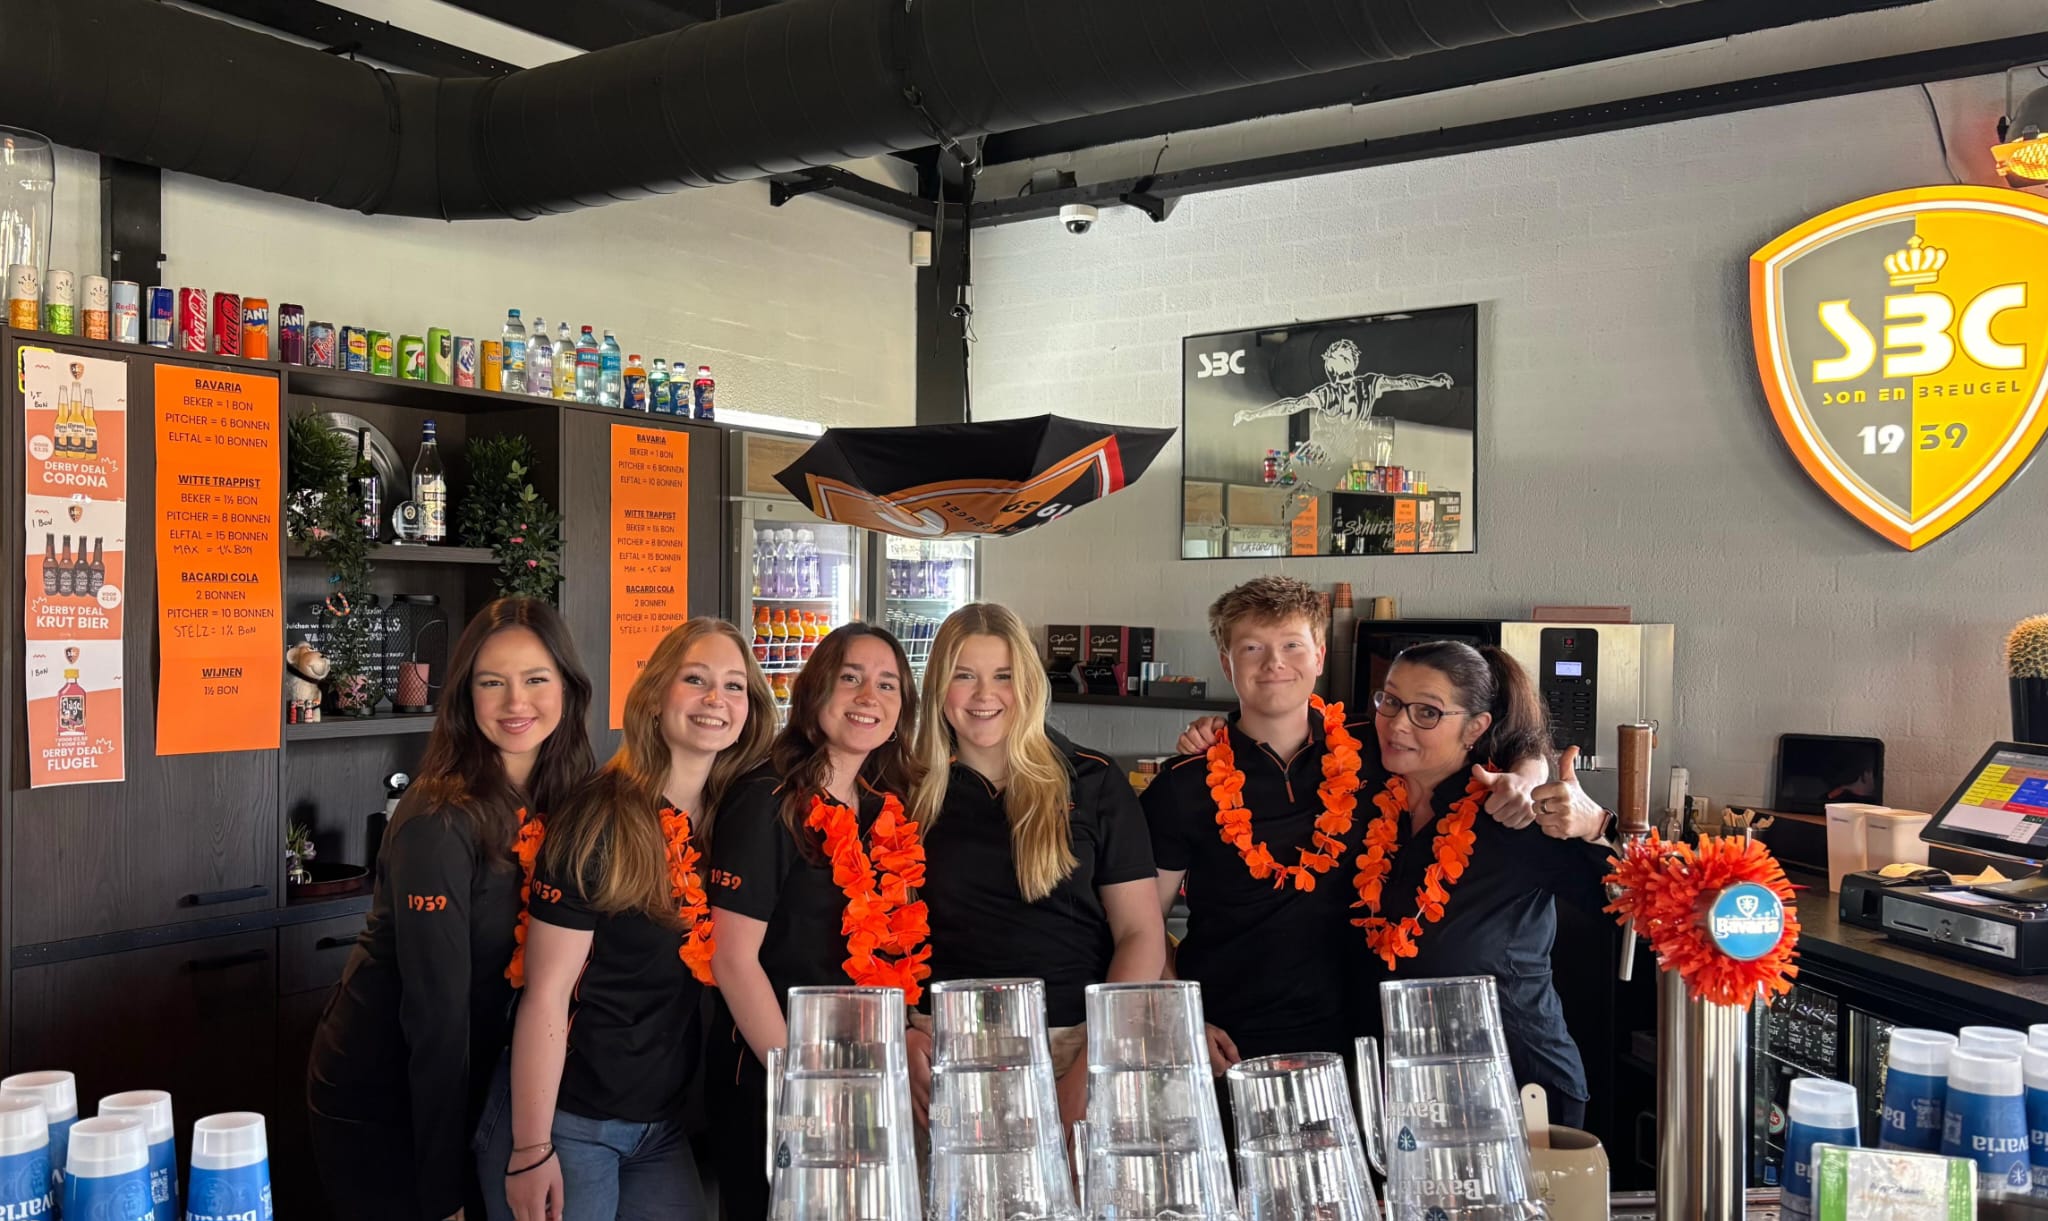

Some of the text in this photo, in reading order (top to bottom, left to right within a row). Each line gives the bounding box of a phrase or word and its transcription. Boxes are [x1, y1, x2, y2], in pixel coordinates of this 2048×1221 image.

[243, 307, 269, 322] FANT
[280, 313, 304, 327] FANT
[1811, 281, 2029, 385] SBC
[1197, 349, 1246, 378] SBC
[195, 378, 242, 392] BAVARIA
[1822, 380, 2021, 405] SON EN BREUGEL
[183, 396, 213, 408] BEKER
[232, 401, 253, 411] BON
[165, 412, 208, 425] PITCHER
[220, 418, 227, 427] 6
[230, 419, 270, 431] BONNEN
[168, 432, 202, 443] ELFTAL
[215, 436, 224, 445] 10
[227, 436, 268, 448] BONNEN
[636, 434, 666, 445] BAVARIA
[629, 447, 648, 456] BEKER
[659, 449, 673, 459] BON
[44, 461, 107, 474] DERBY DEAL
[618, 461, 645, 470] PITCHER
[658, 464, 684, 474] BONNEN
[43, 471, 108, 488] CORONA
[178, 474, 261, 488] WITTE TRAPPIST
[620, 476, 642, 485] ELFTAL
[656, 478, 683, 488] BONNEN
[181, 493, 211, 503] BEKER
[236, 495, 258, 506] BON
[166, 511, 209, 522] PITCHER
[221, 512, 228, 522] 8
[230, 513, 271, 524] BONNEN
[624, 509, 676, 520] WITTE TRAPPIST
[626, 523, 645, 531] BEKER
[660, 525, 675, 533] BON
[169, 529, 202, 539] ELFTAL
[215, 530, 226, 540] 15
[228, 531, 269, 541] BONNEN
[617, 537, 644, 546] PITCHER
[656, 538, 683, 548] BONNEN
[619, 552, 640, 560] ELFTAL
[655, 553, 681, 561] BONNEN
[181, 571, 259, 583] BACARDI COLA
[196, 590, 246, 600] 2 BONNEN
[626, 585, 675, 593] BACARDI COLA
[640, 599, 667, 607] BONNEN
[41, 605, 104, 616] DERBY DEAL
[167, 608, 209, 618] PITCHER
[221, 608, 231, 617] 10
[233, 609, 274, 617] BONNEN
[616, 613, 643, 621] PITCHER
[657, 613, 684, 621] BONNEN
[36, 616, 109, 629] KRUT BIER
[202, 668, 243, 678] WIJNEN
[217, 686, 239, 695] BON
[42, 746, 103, 758] DERBY DEAL
[47, 756, 98, 771] FLUGEL
[711, 868, 742, 891] 1959
[532, 878, 562, 904] 1959
[408, 893, 447, 912] 1959
[1712, 912, 1779, 939] Bavaria
